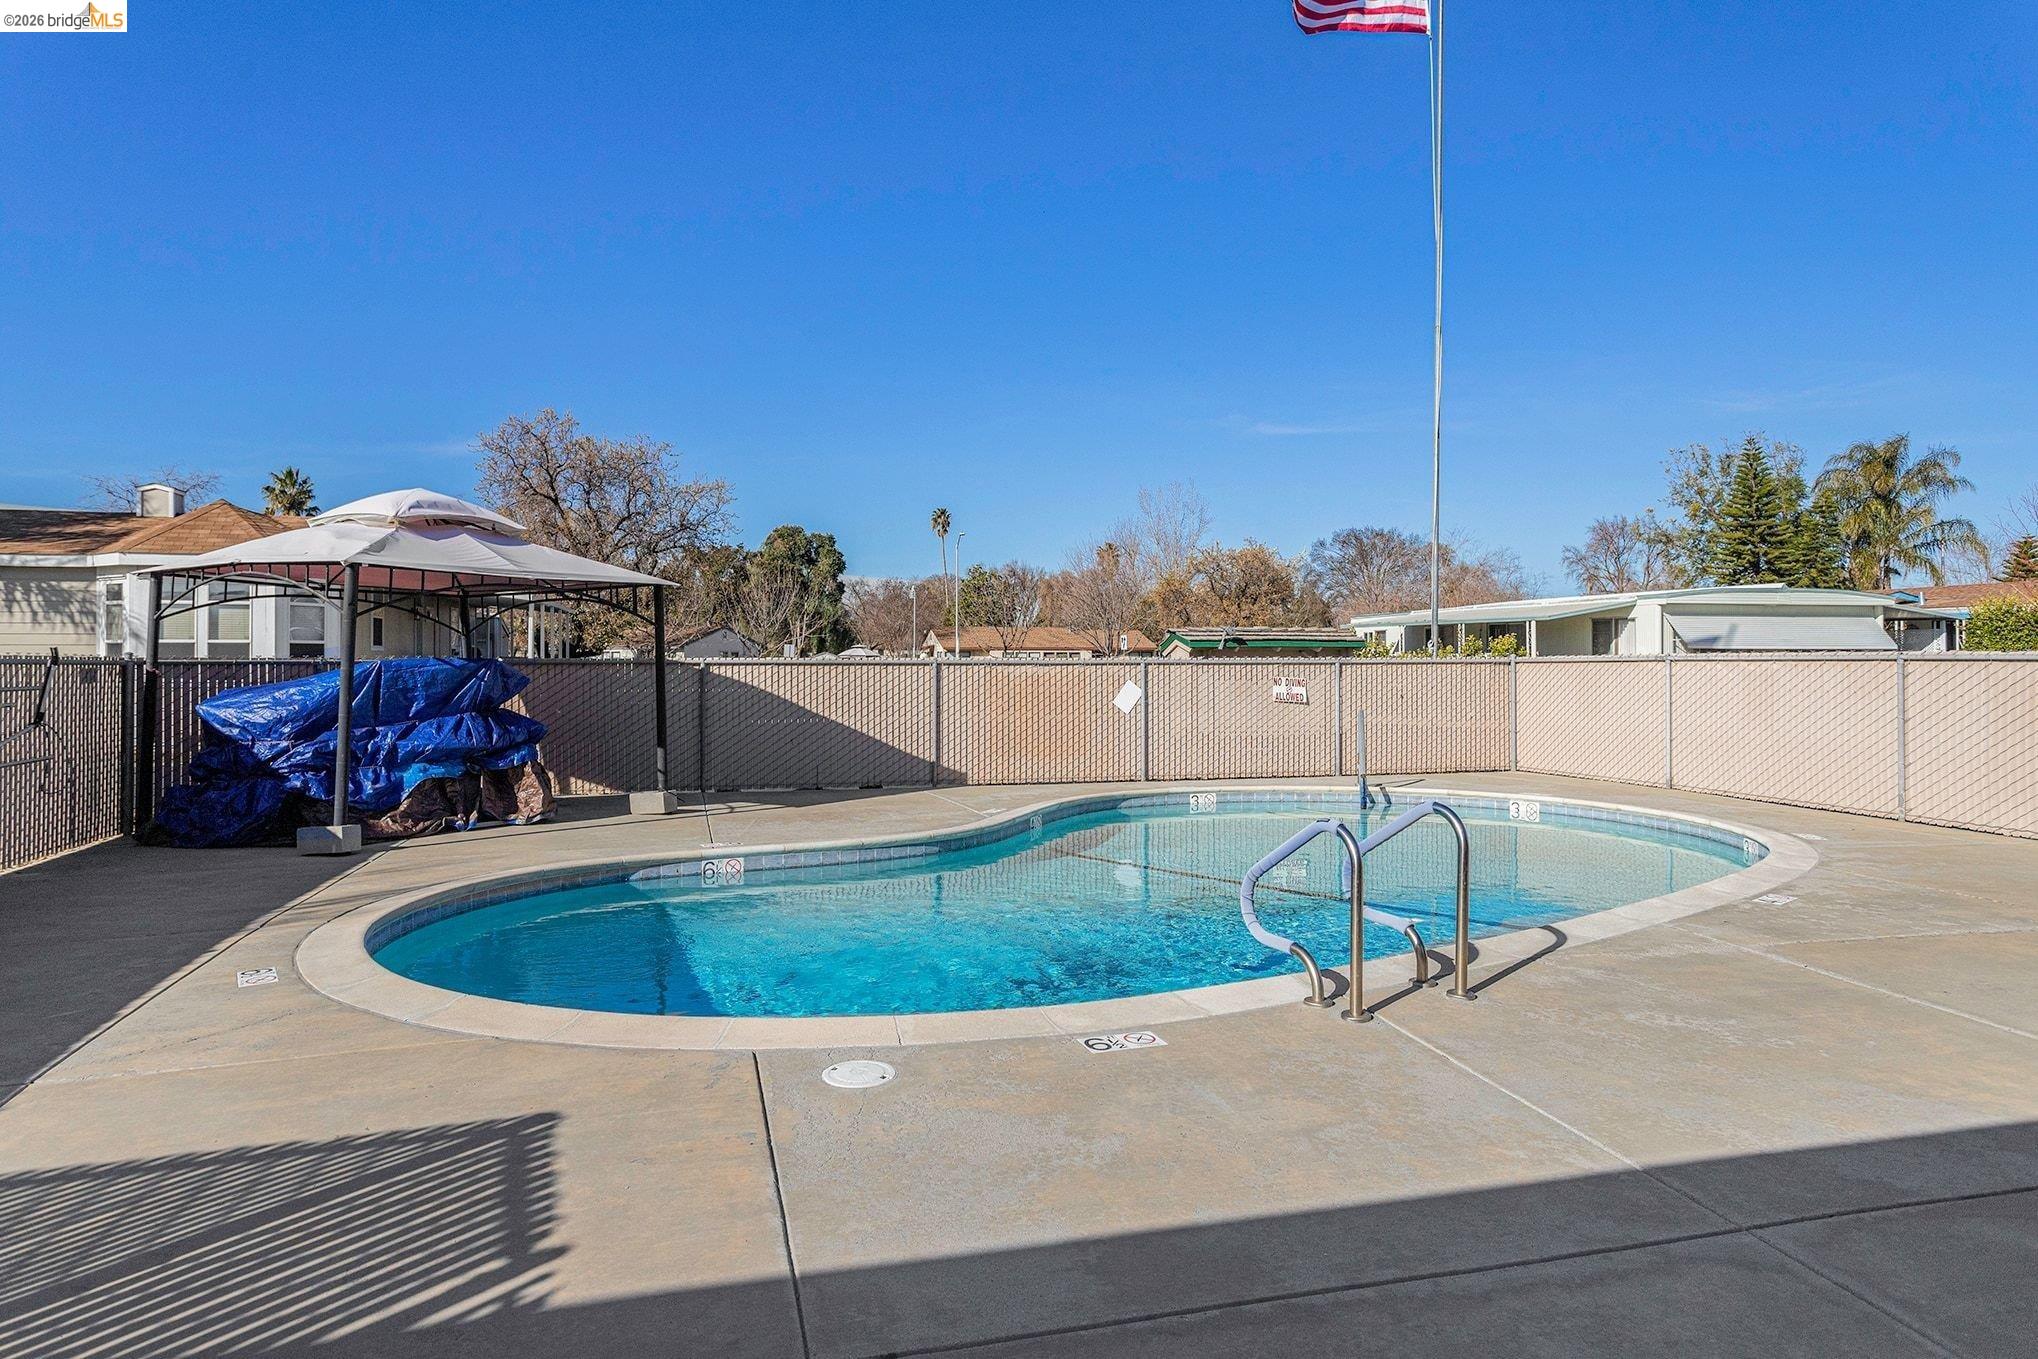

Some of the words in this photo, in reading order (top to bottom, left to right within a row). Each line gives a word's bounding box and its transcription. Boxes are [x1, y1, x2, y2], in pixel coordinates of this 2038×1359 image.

[1273, 677, 1283, 686] NO
[1285, 678, 1305, 687] DIVING
[1275, 692, 1304, 701] ALLOWED
[1511, 802, 1520, 818] 3
